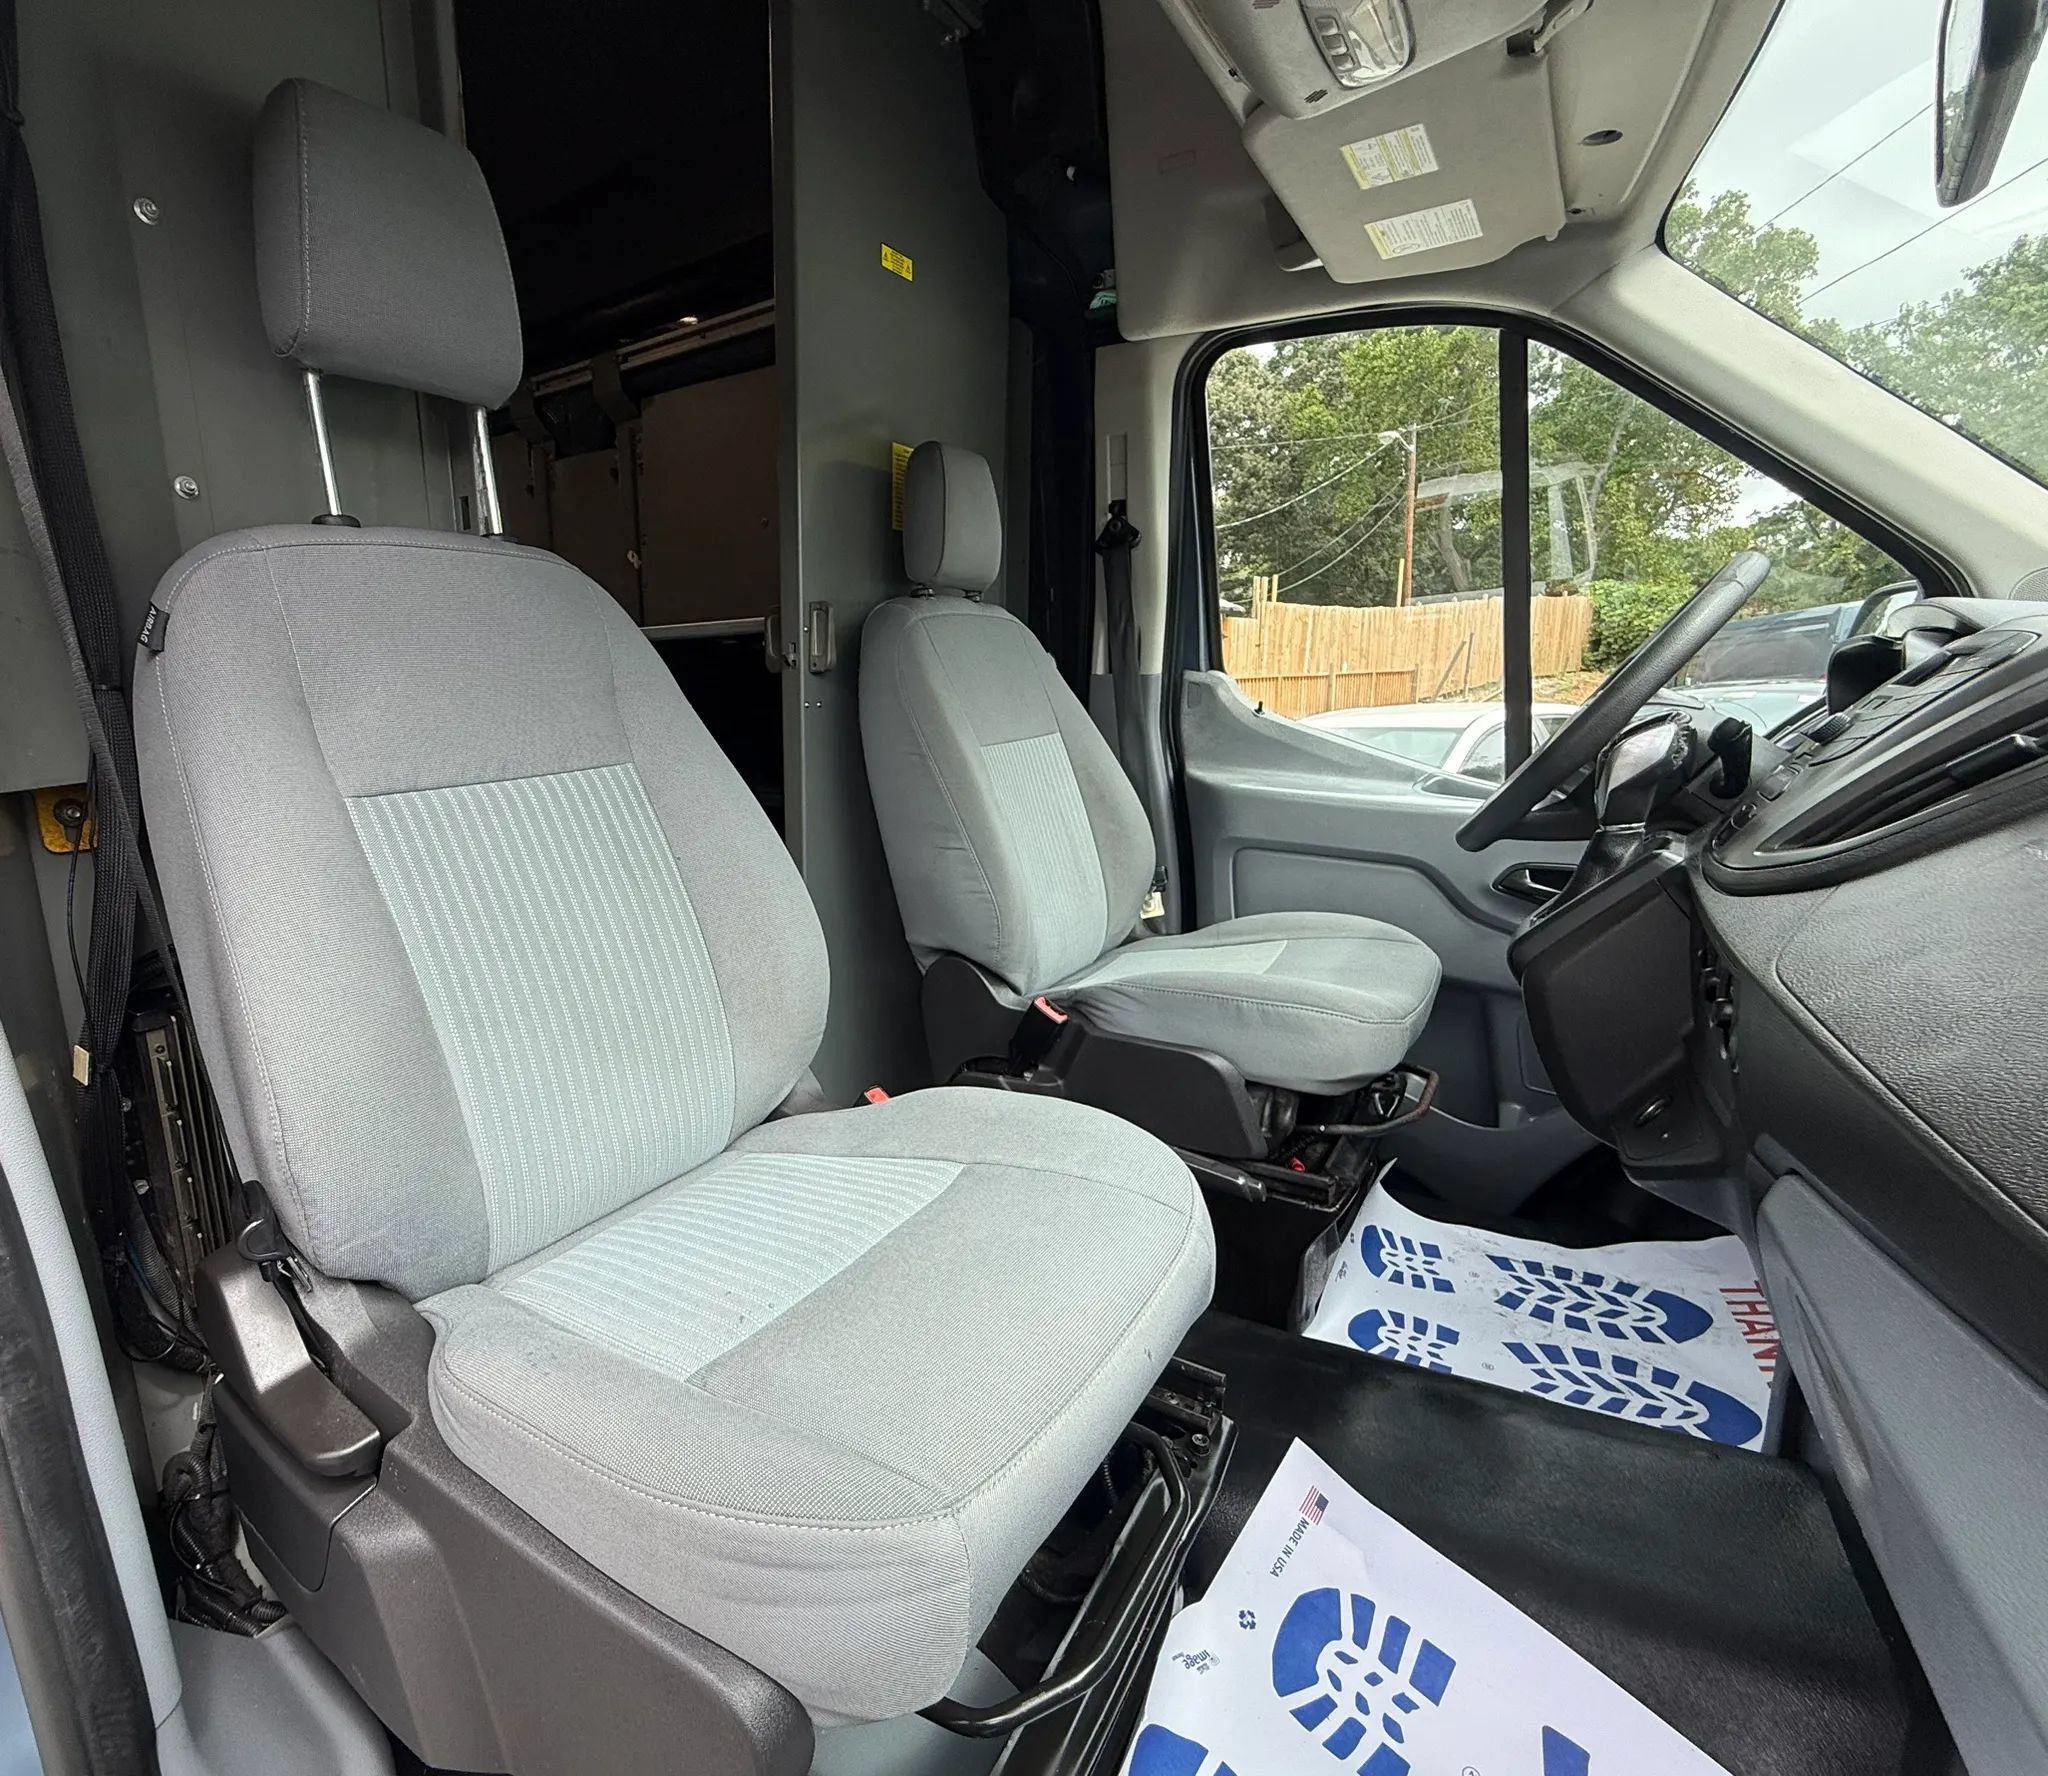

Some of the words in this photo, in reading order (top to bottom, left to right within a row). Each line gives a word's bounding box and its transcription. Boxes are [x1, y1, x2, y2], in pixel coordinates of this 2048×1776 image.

[140, 606, 157, 643] AIRBAG
[1288, 1516, 1310, 1547] MADE
[1281, 1544, 1295, 1558] IN
[1269, 1556, 1288, 1577] USA
